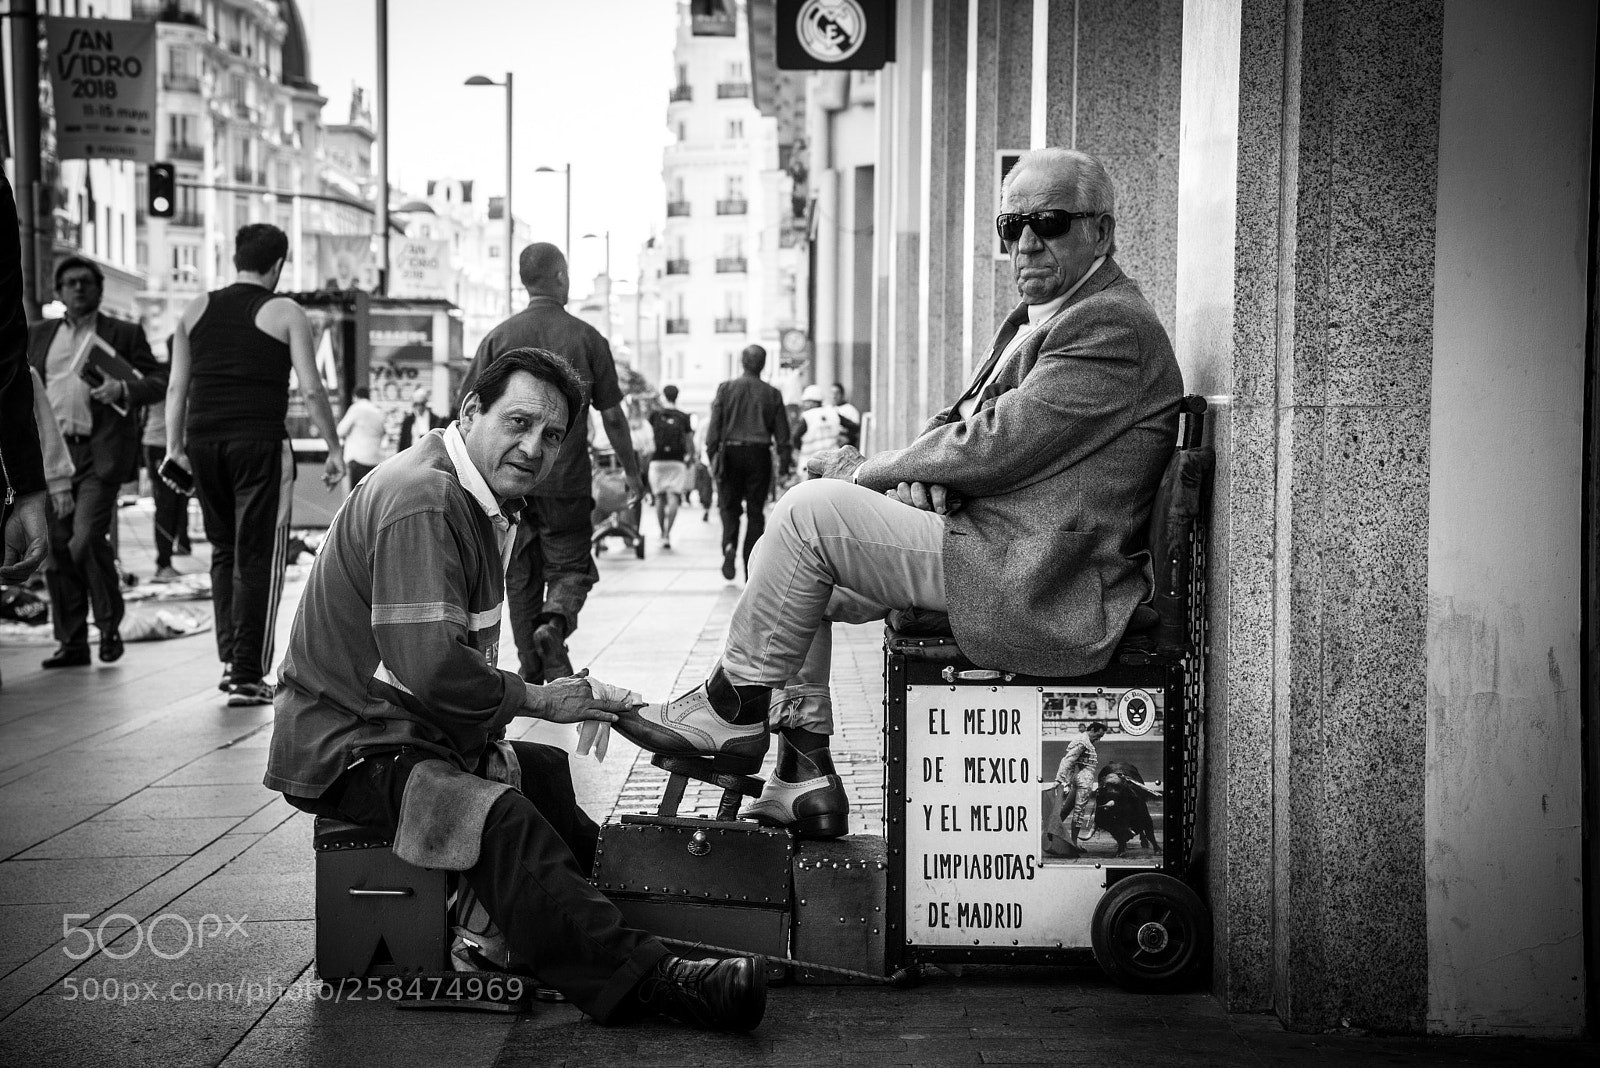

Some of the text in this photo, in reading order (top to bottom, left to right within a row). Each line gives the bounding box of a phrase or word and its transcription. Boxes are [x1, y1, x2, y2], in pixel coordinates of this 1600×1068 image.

[62, 28, 113, 55] SAN
[72, 78, 118, 99] 2018
[928, 708, 1021, 736] EL MEJOR
[923, 757, 1029, 784] DE MEXICO
[923, 804, 1028, 832] Y EL MEJOR
[923, 853, 1035, 880] LIMPIABOTAS
[928, 901, 1023, 929] DE MADRID
